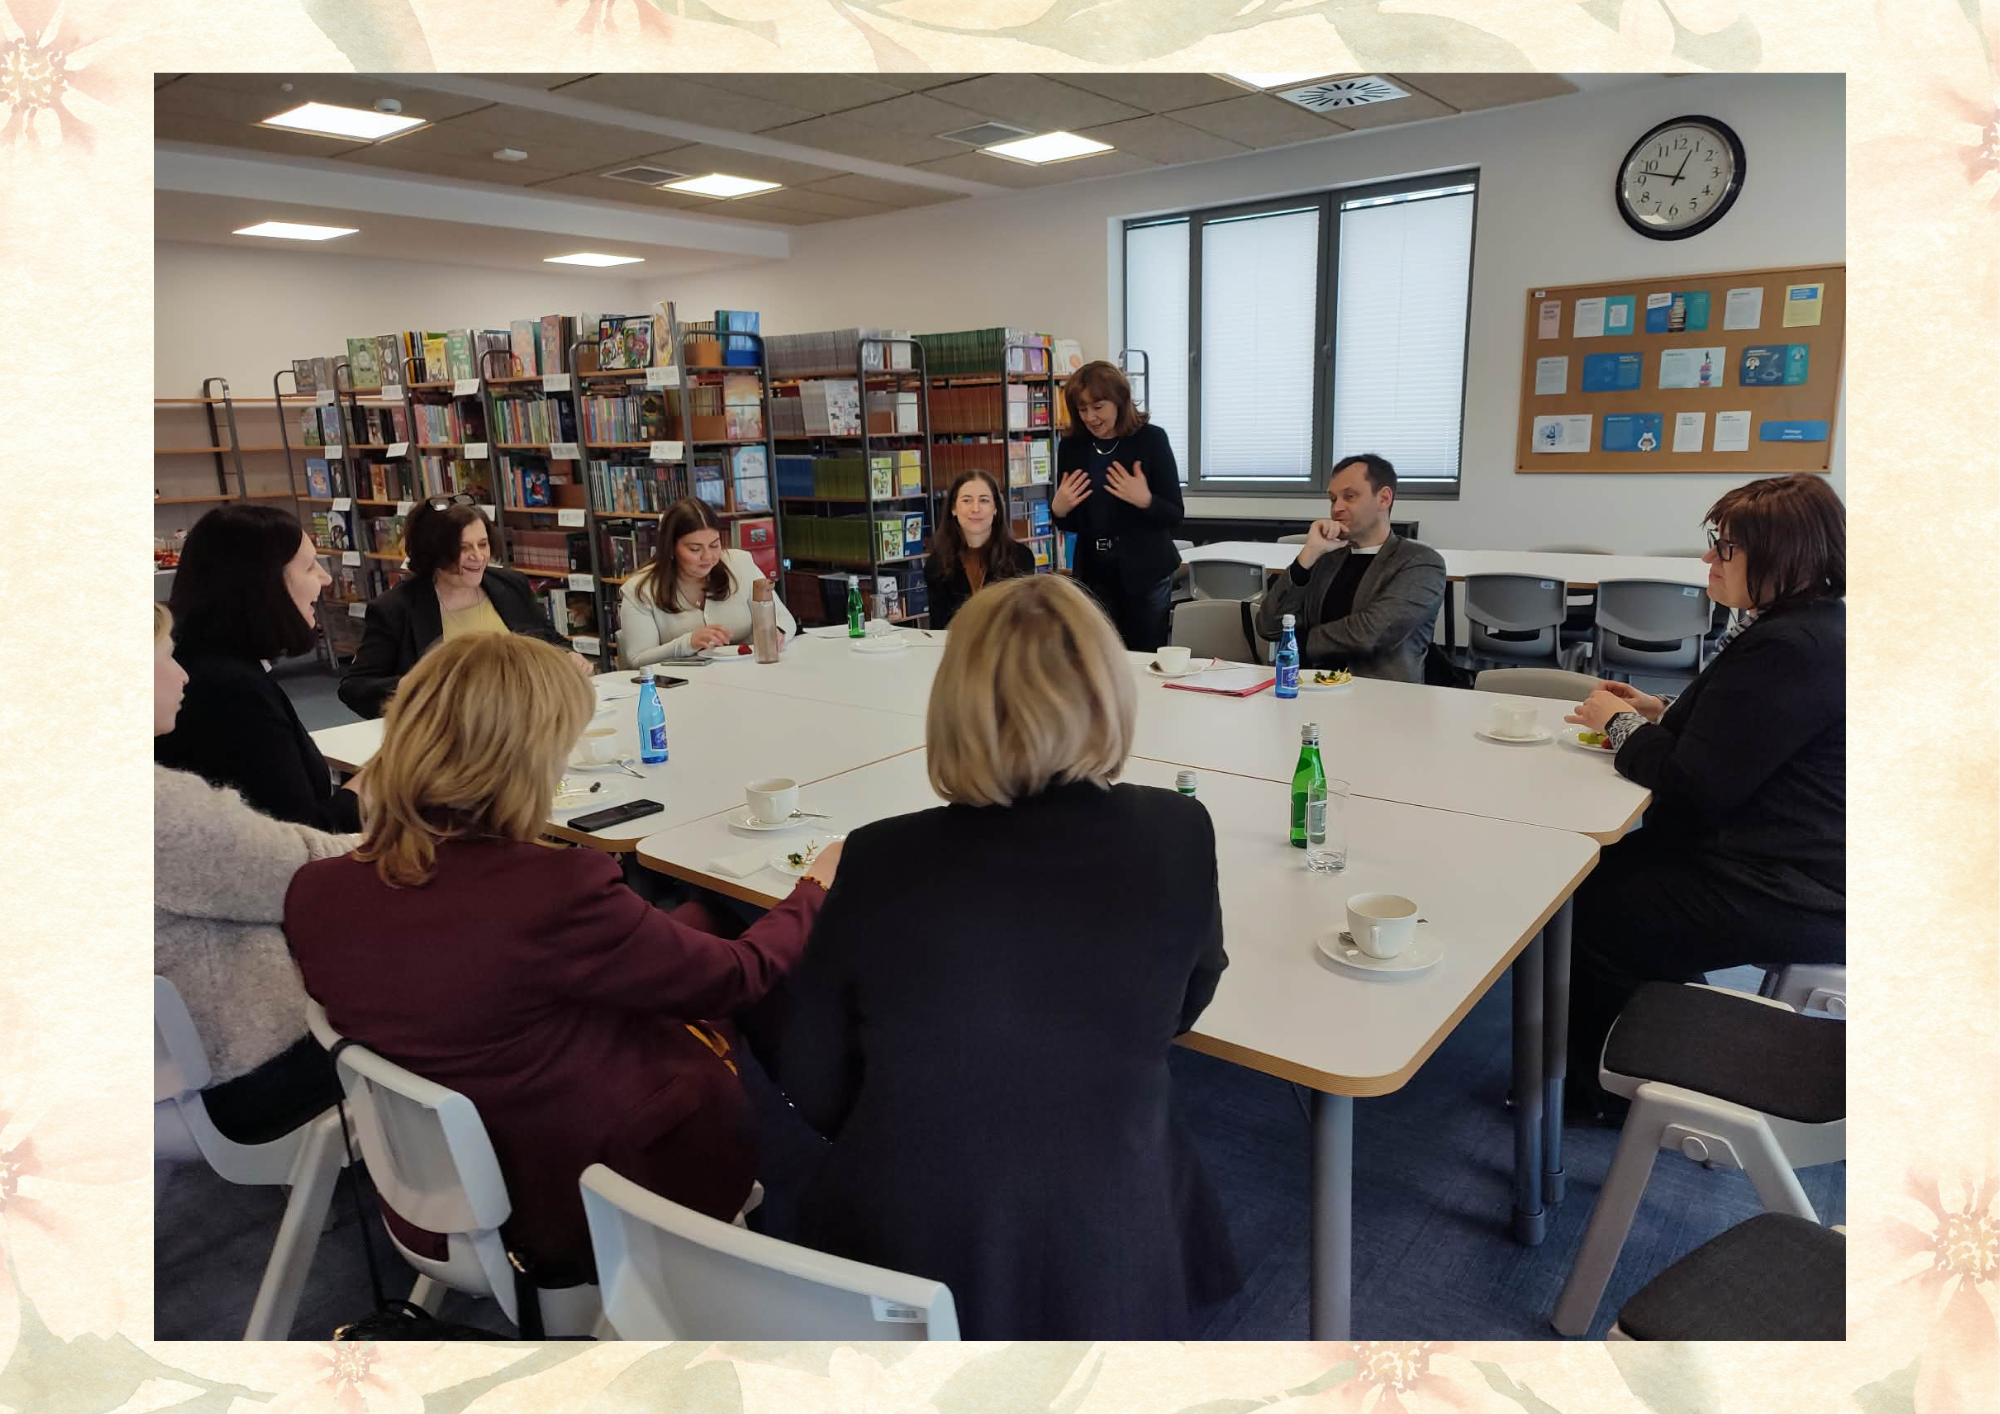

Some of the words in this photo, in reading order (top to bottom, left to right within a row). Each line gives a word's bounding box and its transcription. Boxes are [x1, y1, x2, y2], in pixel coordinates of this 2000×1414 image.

[1674, 138, 1688, 150] 12
[1659, 145, 1669, 157] 11
[1705, 150, 1714, 161] 2
[1645, 160, 1659, 172] 10
[1711, 166, 1720, 179] 3
[1637, 174, 1647, 186] 9
[1701, 184, 1711, 196] 4
[1640, 191, 1650, 203] 8
[1689, 197, 1698, 209] 5
[1655, 201, 1662, 213] 7
[1668, 204, 1679, 216] 6
